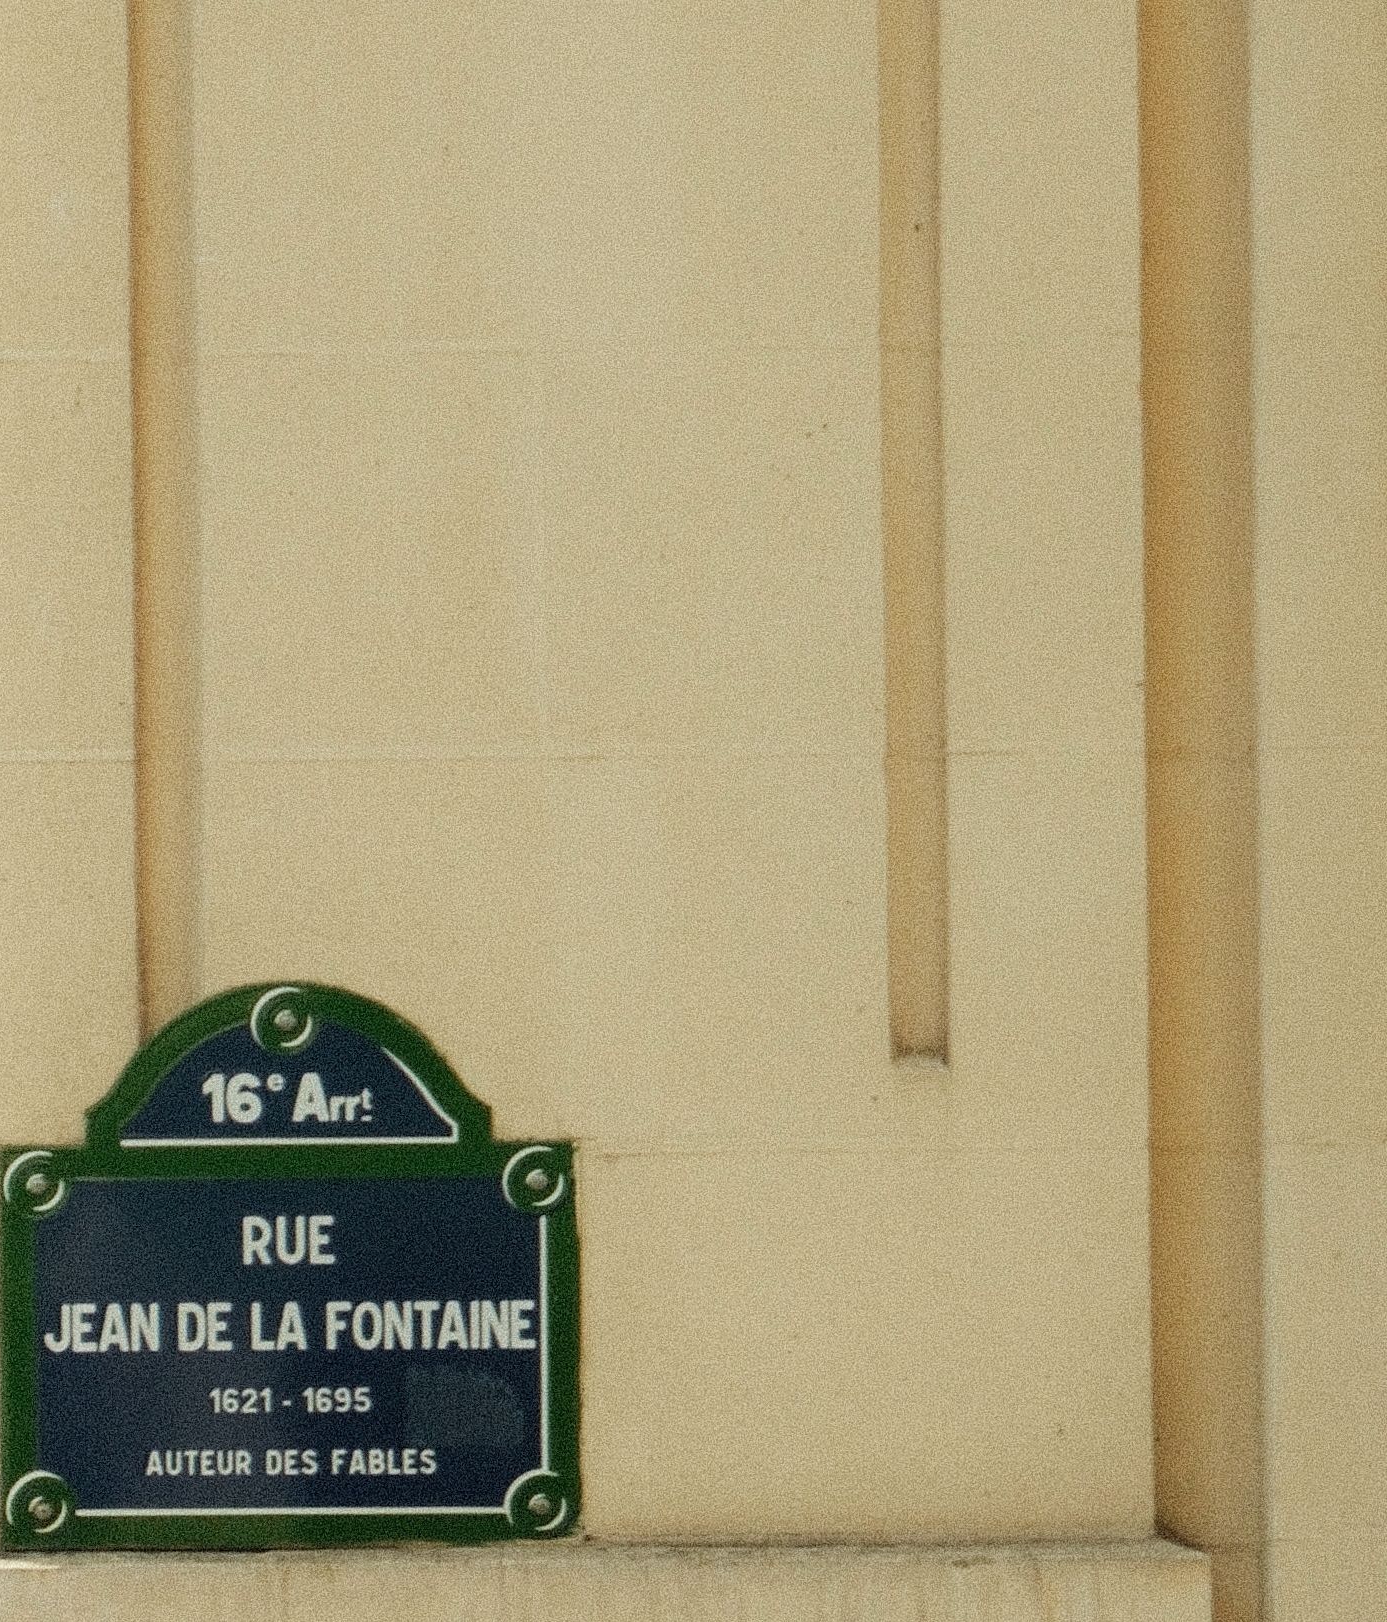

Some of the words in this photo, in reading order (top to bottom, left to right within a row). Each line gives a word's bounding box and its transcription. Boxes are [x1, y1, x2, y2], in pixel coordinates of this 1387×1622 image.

[242, 1214, 336, 1266] RUE
[44, 1302, 161, 1353] JEAN
[177, 1301, 234, 1352] DE
[250, 1301, 308, 1352] LA
[325, 1299, 537, 1351] FONTAINE
[209, 1387, 272, 1414] 1621
[302, 1386, 372, 1413] 1695
[145, 1449, 253, 1477] AUTEUR
[265, 1448, 319, 1476] DES
[331, 1448, 437, 1476] FABLES
